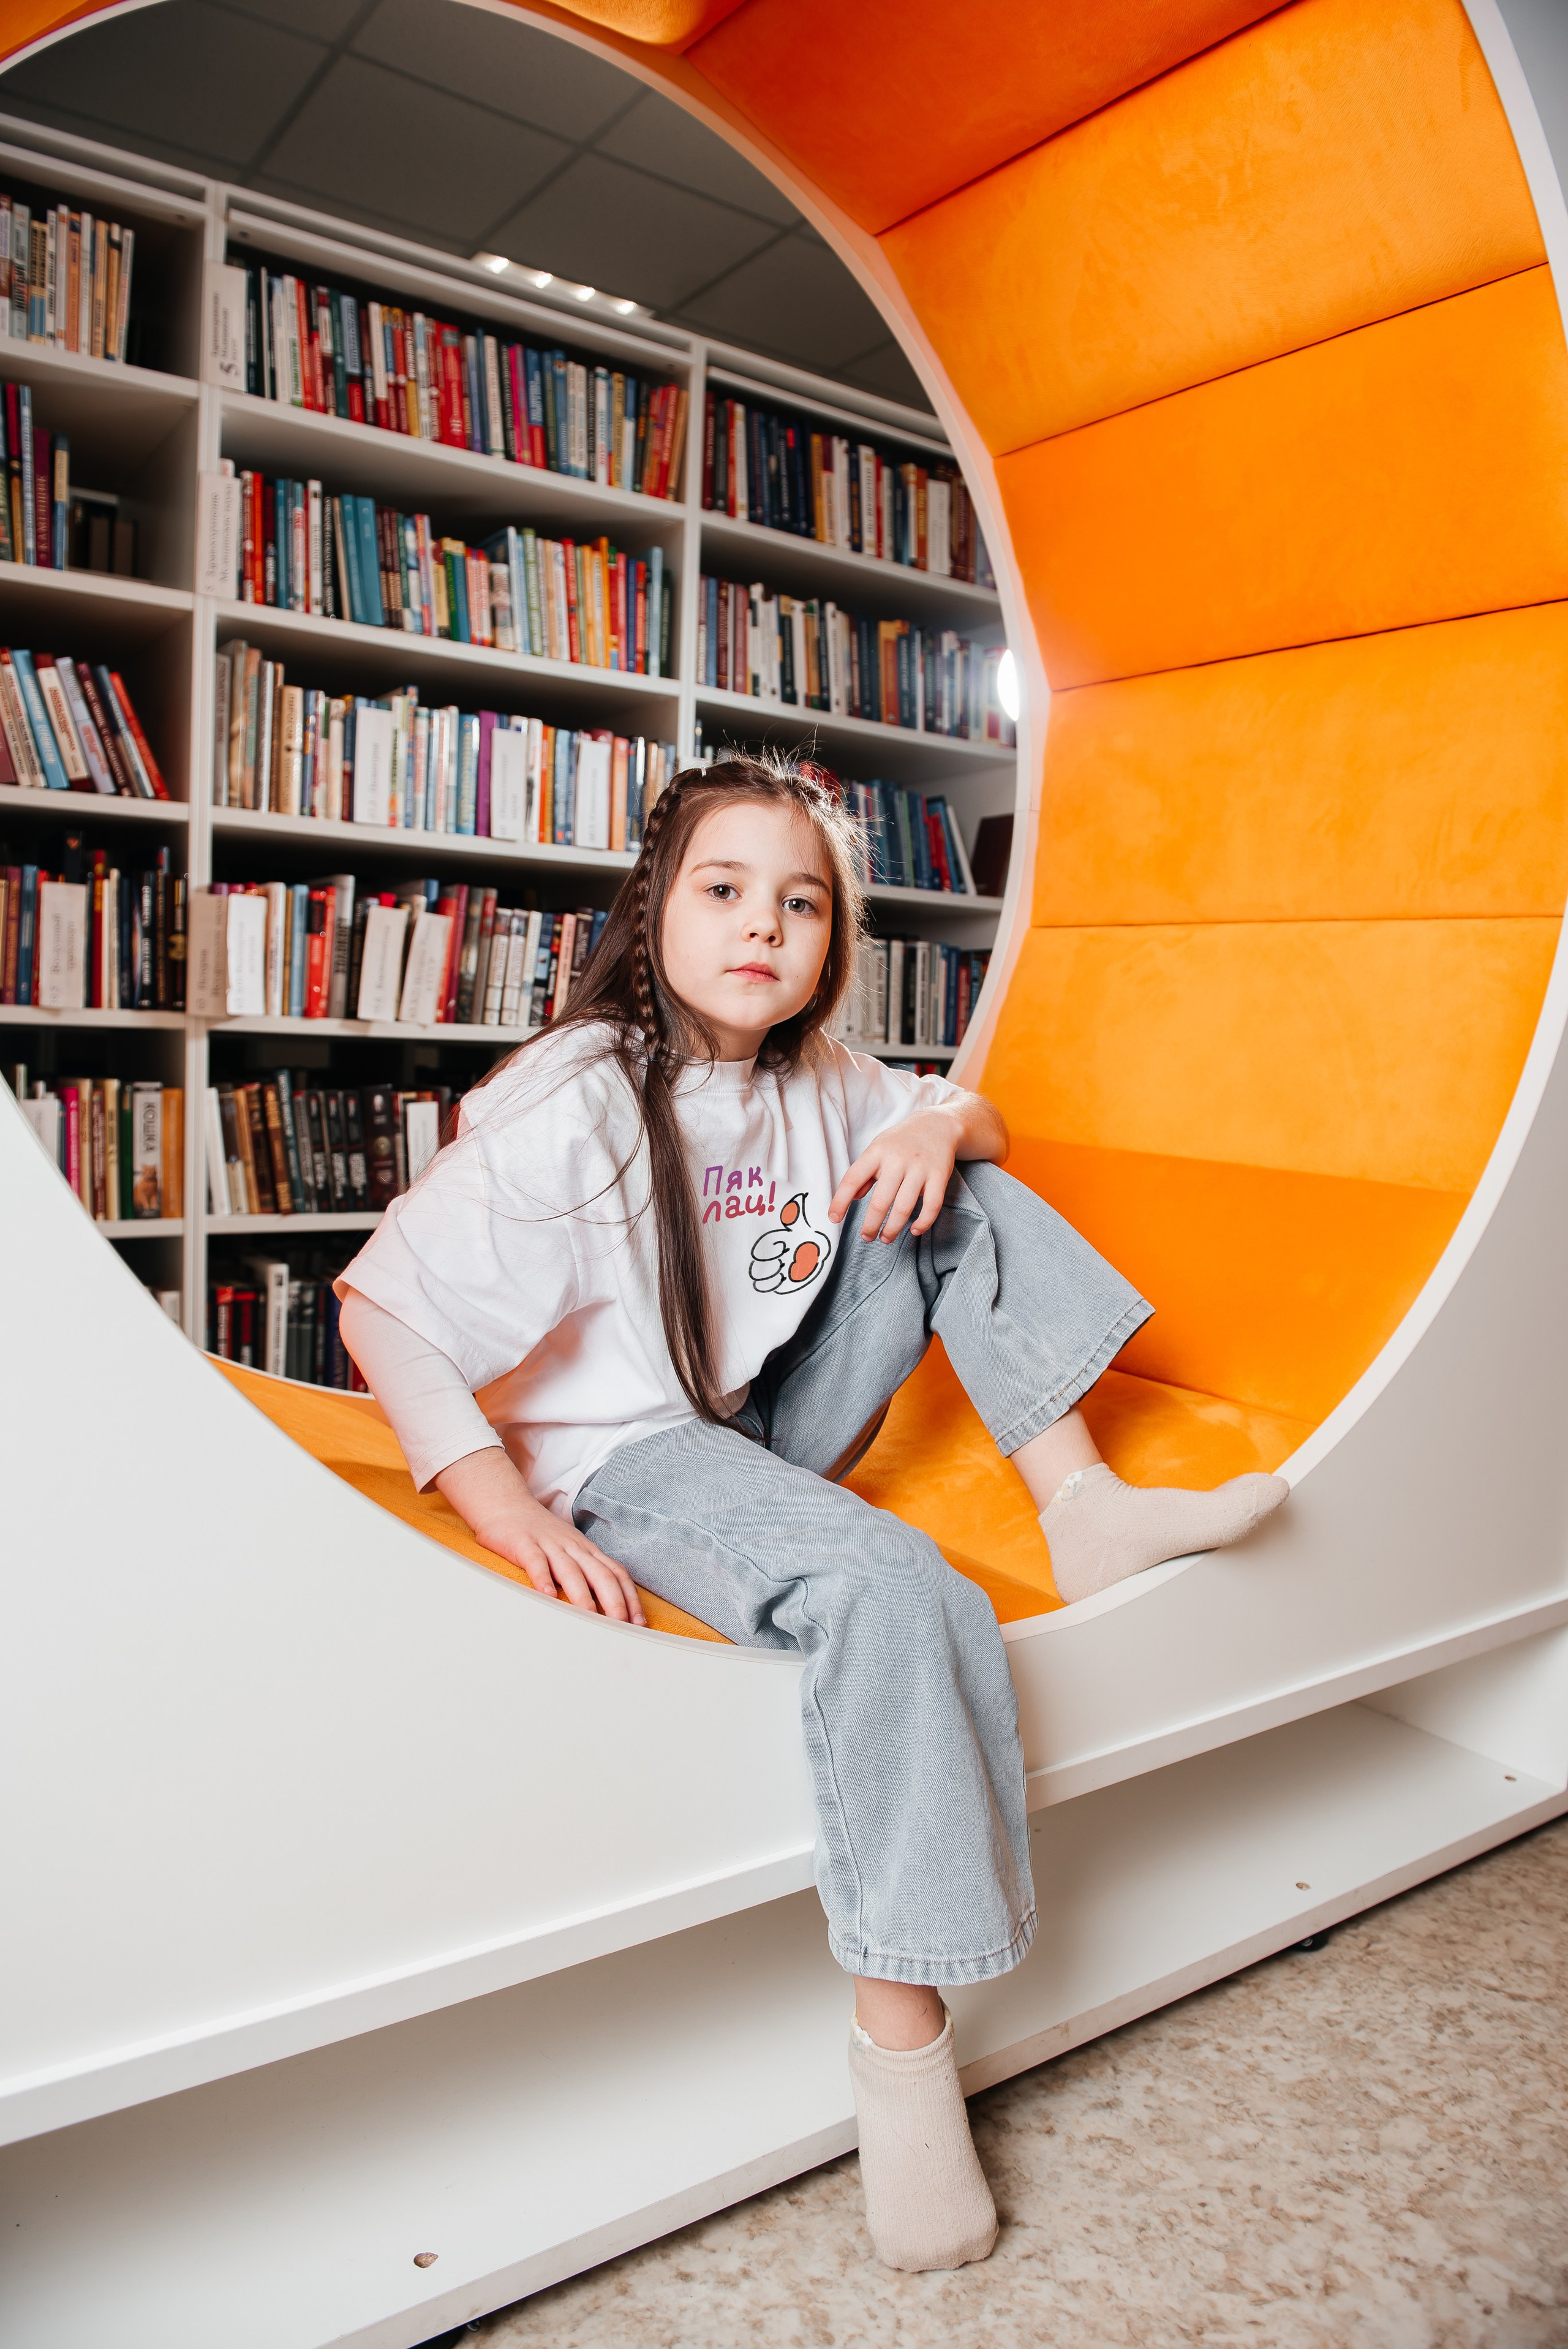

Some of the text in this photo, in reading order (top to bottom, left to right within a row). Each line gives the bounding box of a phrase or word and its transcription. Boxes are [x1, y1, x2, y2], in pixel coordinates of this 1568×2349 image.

[221, 363, 239, 375] 5
[143, 1102, 157, 1153] КОШКА
[703, 1166, 763, 1196] Пяк
[703, 1180, 776, 1224] лац!
